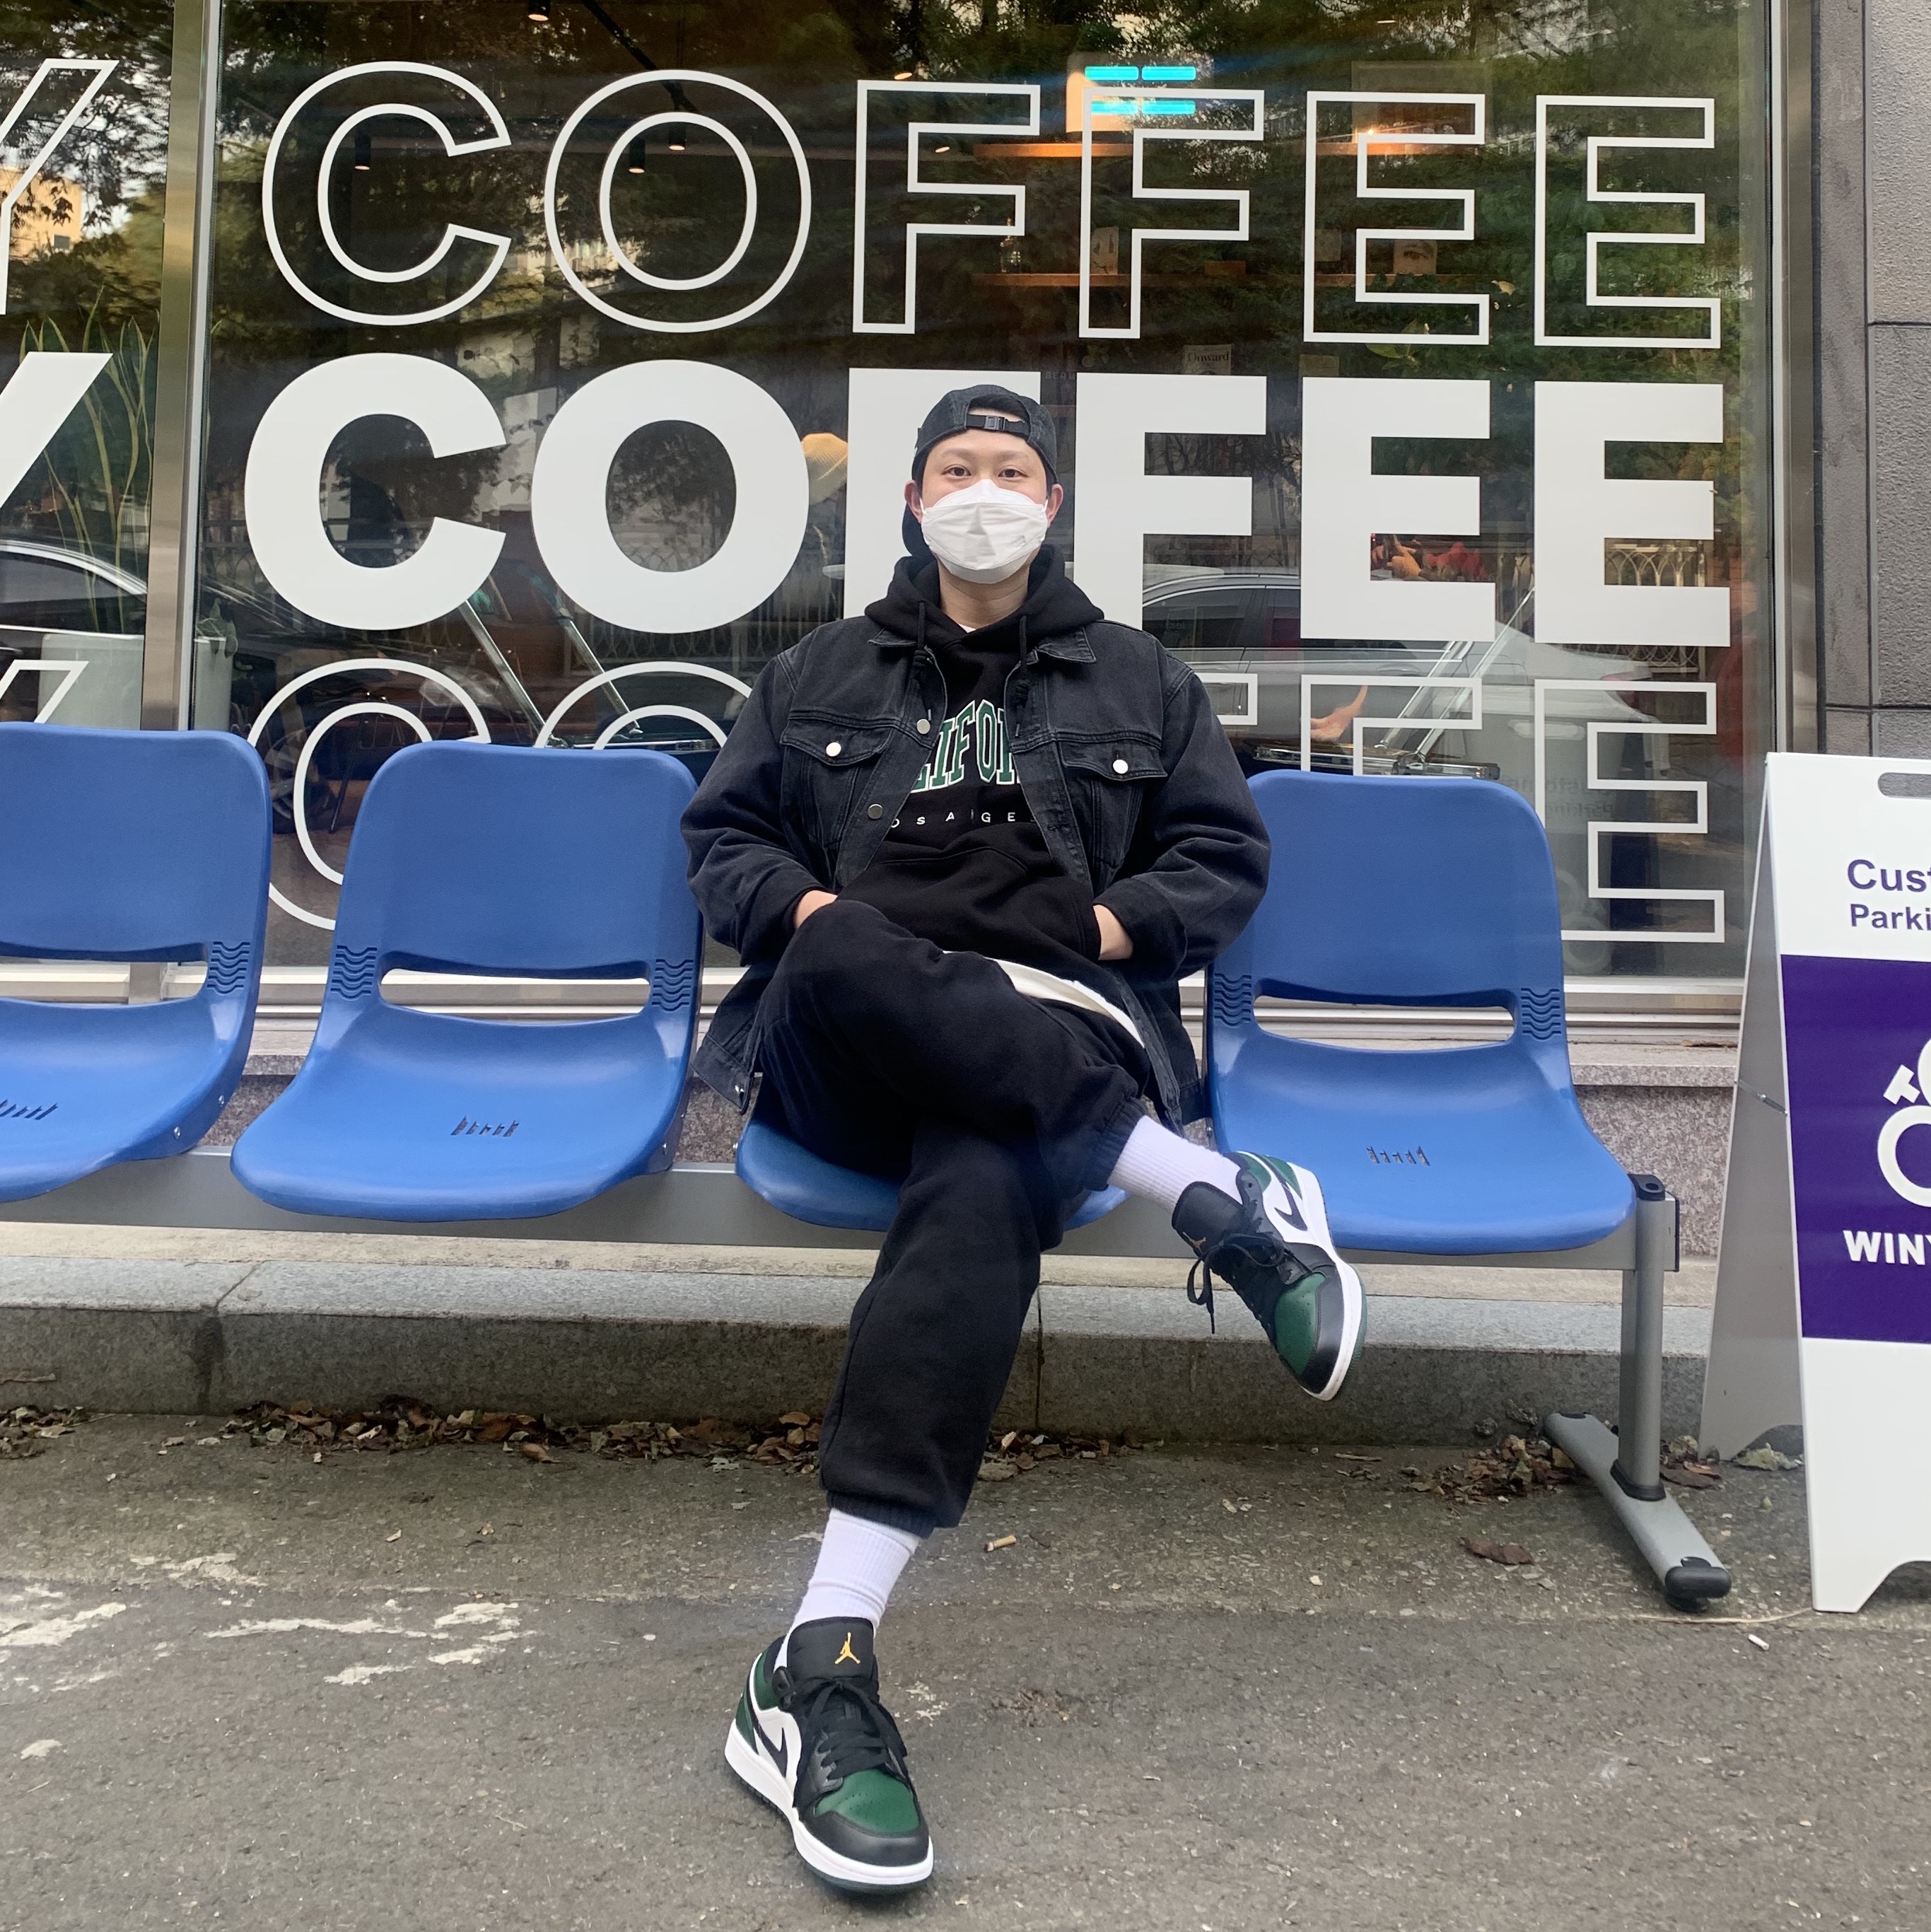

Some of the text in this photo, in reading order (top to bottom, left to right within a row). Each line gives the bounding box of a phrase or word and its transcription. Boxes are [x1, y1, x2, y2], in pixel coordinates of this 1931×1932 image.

[262, 61, 1722, 349] COFFEE
[1187, 351, 1230, 362] Onward
[244, 352, 1732, 647] COFFEE
[1850, 903, 1931, 931] Parki
[1842, 1230, 1931, 1266] WIN
